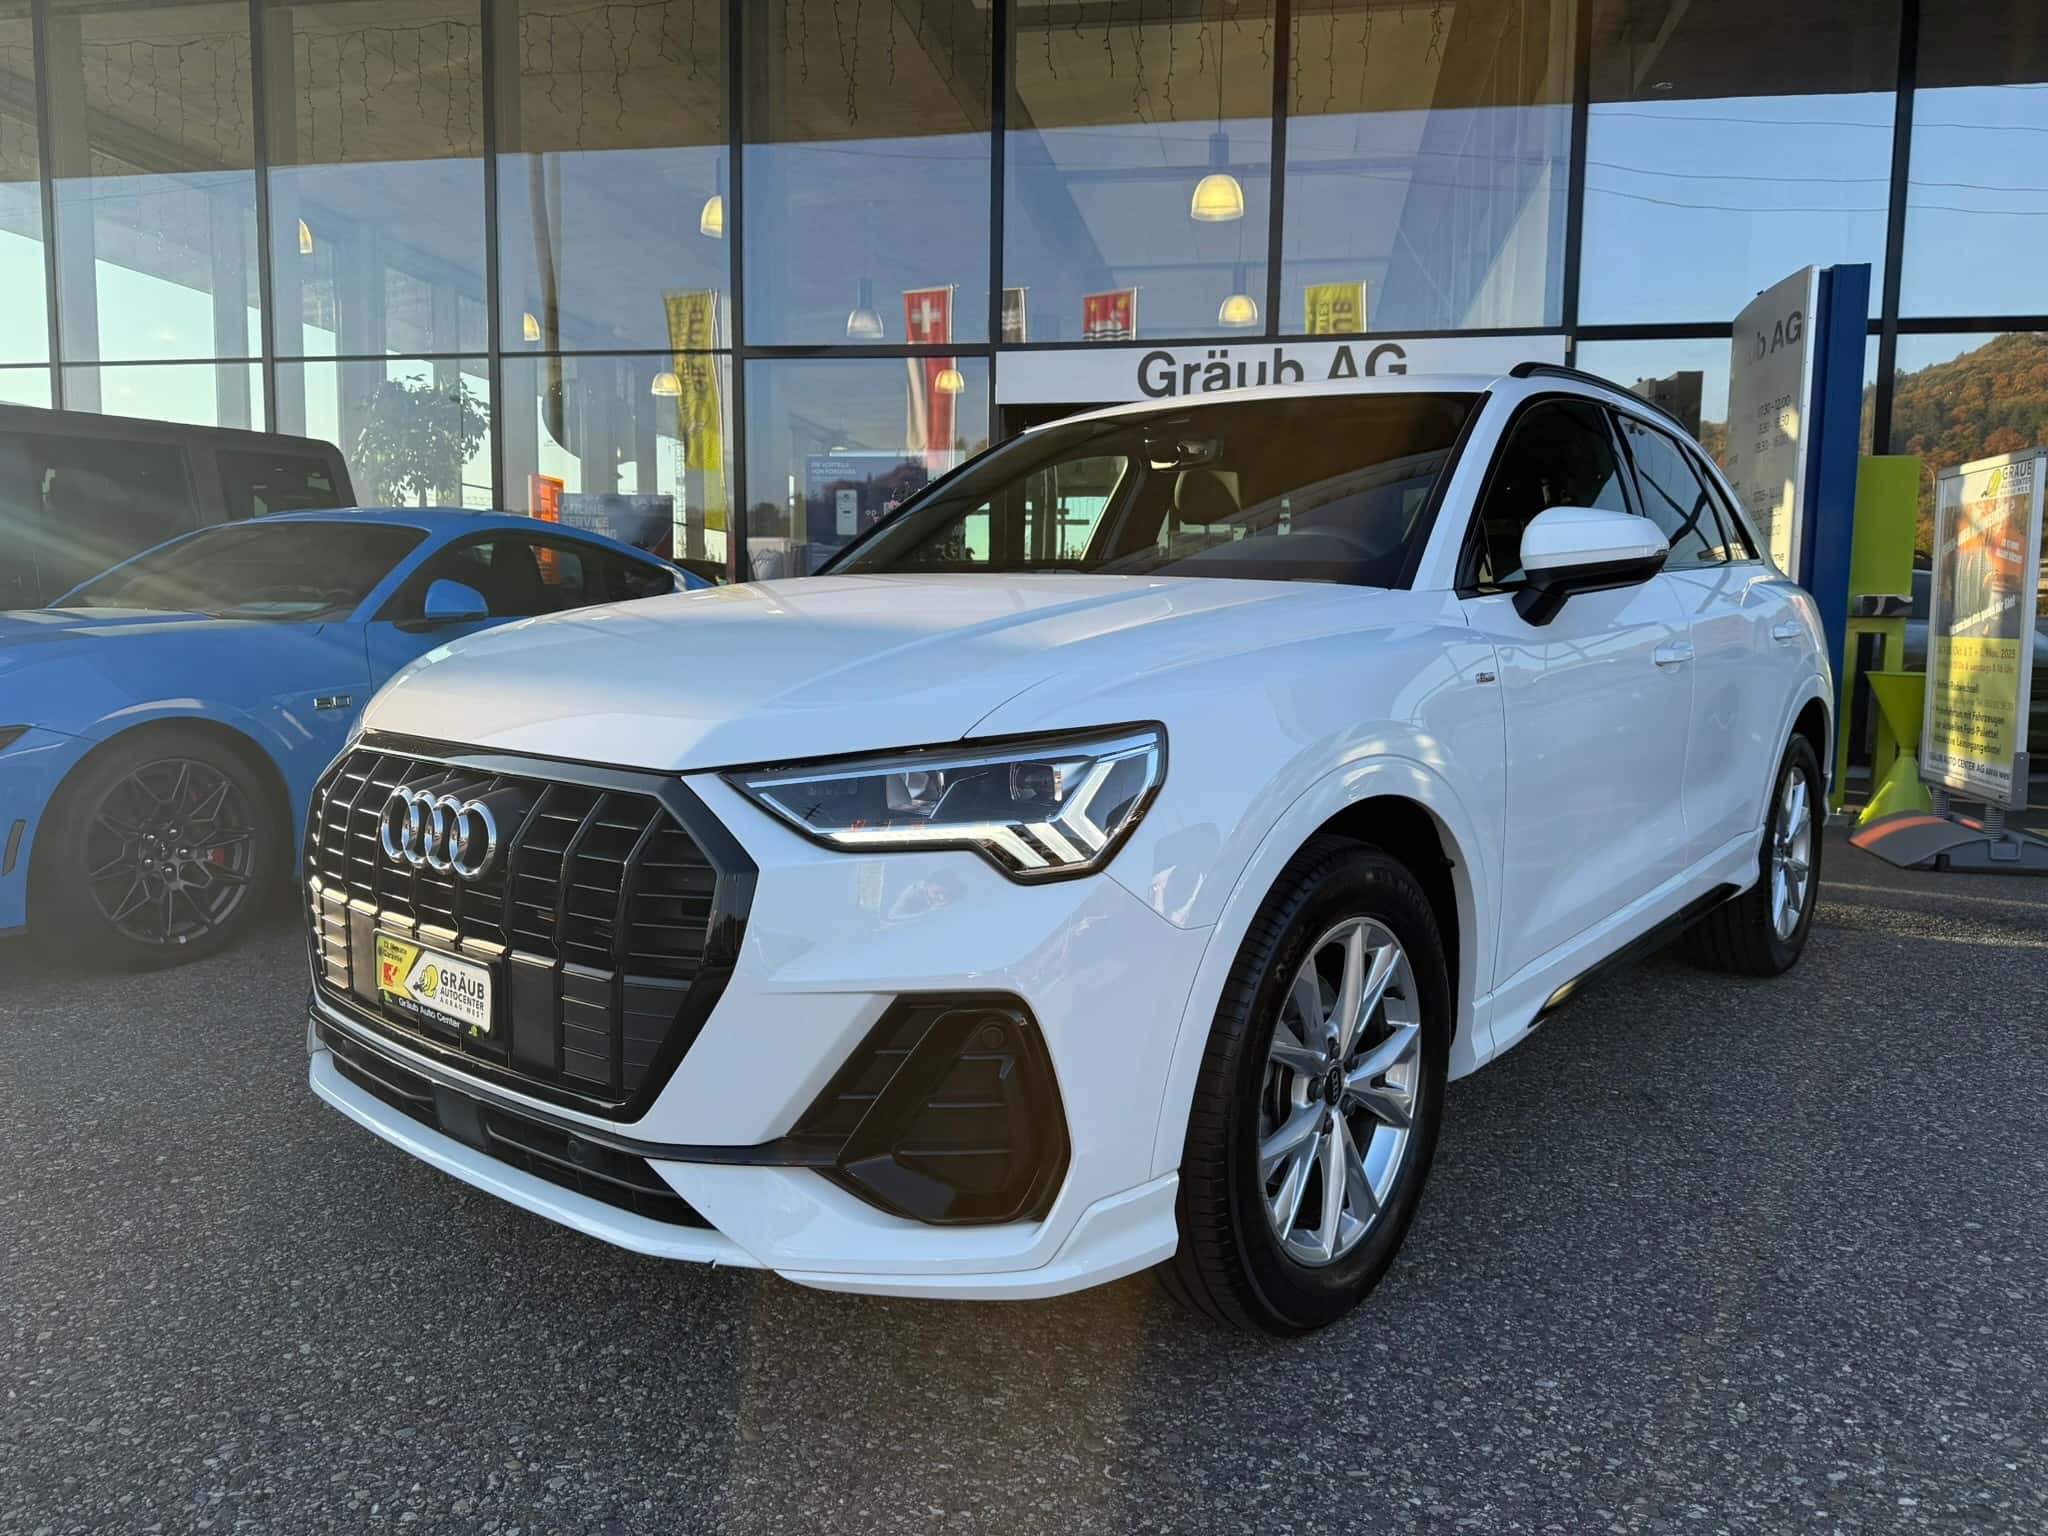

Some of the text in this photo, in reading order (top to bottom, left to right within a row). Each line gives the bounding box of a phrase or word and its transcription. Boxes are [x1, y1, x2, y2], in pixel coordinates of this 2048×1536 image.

[1770, 311, 1803, 354] AG
[1137, 343, 1408, 398] Gräub AG
[440, 969, 485, 1000] GRÄUB
[440, 986, 485, 1012] AUTOCENTER
[436, 1011, 461, 1030] Center
